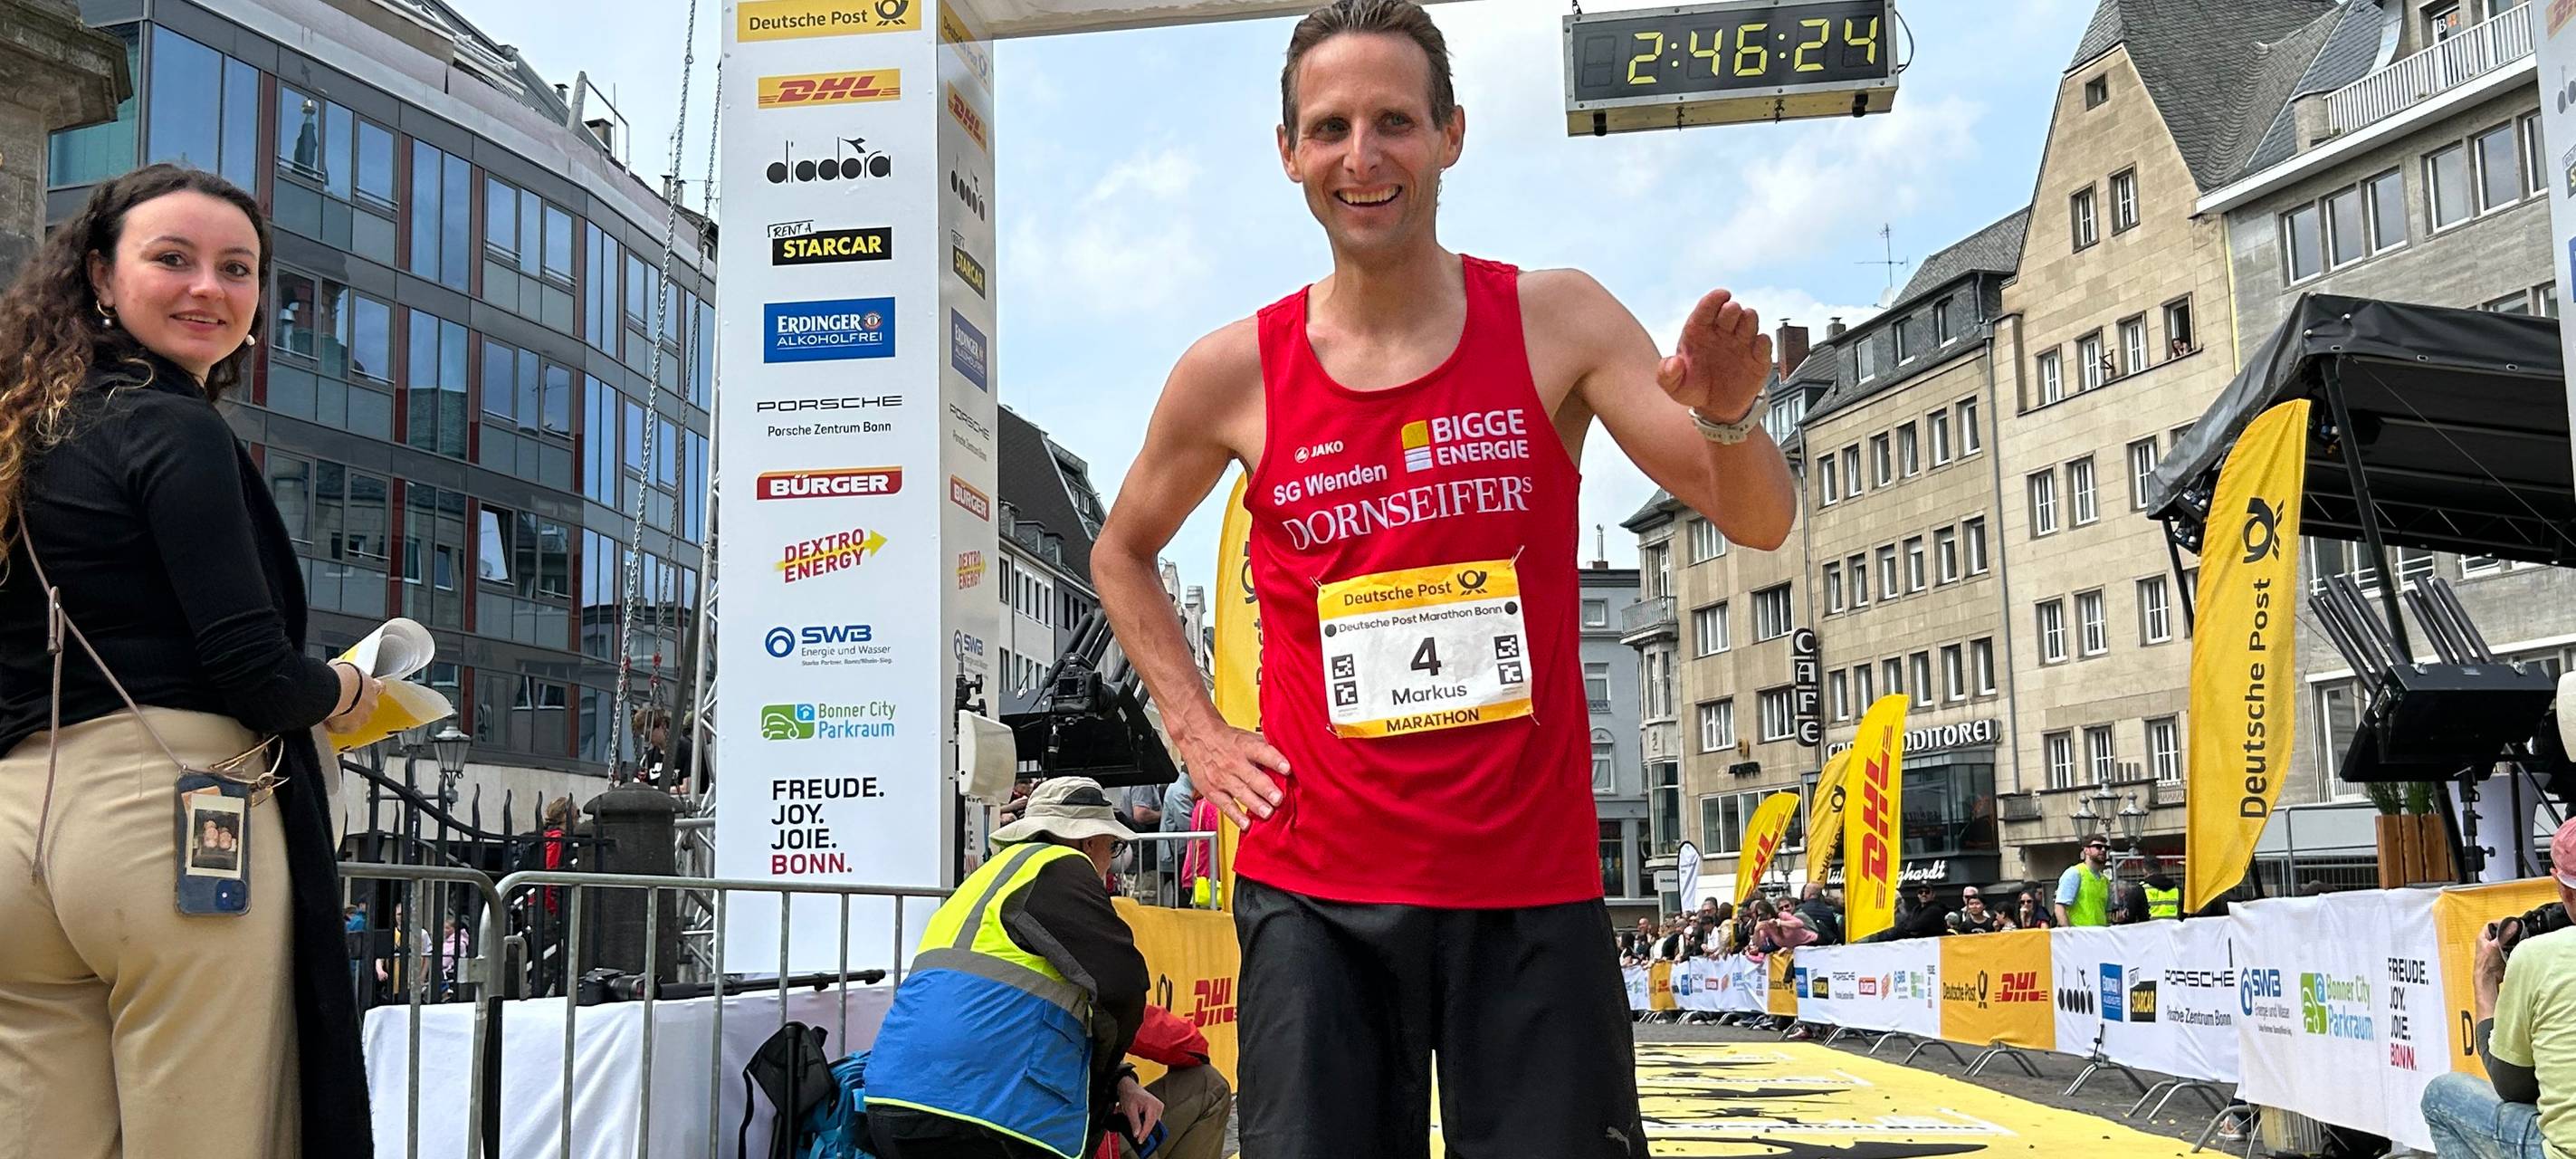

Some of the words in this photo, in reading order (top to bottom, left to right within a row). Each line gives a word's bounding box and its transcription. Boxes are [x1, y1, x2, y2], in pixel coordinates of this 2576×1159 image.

[749, 14, 827, 32] Deutsche
[831, 9, 869, 25] Post
[1627, 16, 1880, 86] 2:46:24
[777, 75, 885, 103] DHL
[953, 93, 983, 141] DHL
[766, 137, 892, 185] diadora
[773, 225, 802, 238] RENT
[804, 223, 813, 235] A
[783, 235, 883, 259] STARCAR
[956, 251, 984, 289] STARCAR
[777, 314, 863, 335] ERDINGER
[777, 332, 883, 348] ALKOHOLFREI
[757, 396, 903, 414] PORSCHE
[768, 424, 812, 437] Porsche
[814, 423, 861, 436] Zentrum
[863, 421, 892, 435] Bonn
[949, 403, 989, 441] PORSCHE
[1432, 409, 1528, 444] BIGGE
[1311, 440, 1345, 458] JAKO
[1436, 439, 1530, 466] ENERGIE
[769, 474, 890, 498] BÜRGER
[1274, 484, 1302, 507] SG
[1304, 463, 1388, 500] Wenden
[784, 528, 864, 564] DEXTRO
[784, 547, 865, 584] ENERGY
[959, 550, 981, 570] DEXTRO
[959, 573, 981, 589] ENERGY
[1344, 587, 1414, 607] Deutsche
[1418, 580, 1453, 598] Post
[1339, 617, 1390, 634] Deutsche
[1391, 614, 1417, 627] Post
[1419, 608, 1474, 623] Marathon
[1474, 603, 1503, 617] Bonn
[2249, 578, 2273, 652] Post
[801, 625, 873, 644] SWB
[964, 633, 984, 656] SWB
[801, 647, 835, 658] Energie
[837, 646, 855, 655] und
[858, 645, 892, 654] Wasser
[1409, 637, 1443, 677] 4
[1391, 684, 1468, 706] Markus
[1795, 631, 1820, 743] CAFE
[818, 703, 866, 719] Bonner
[869, 702, 896, 721] City
[1386, 708, 1480, 733] MARATHON
[818, 720, 895, 739] Parkraum
[1902, 719, 1991, 752] NDITOREI
[2240, 661, 2268, 819] Deutsche
[772, 777, 885, 801] FREUDE.
[771, 803, 824, 825] JOY.
[1862, 751, 1890, 884] DHL
[771, 828, 837, 850] JOIE.
[772, 853, 853, 875] BONN.
[1896, 859, 1946, 888] ghardt
[2251, 969, 2282, 997] SWB
[2388, 957, 2429, 986] FREUDE.
[1943, 982, 1964, 1001] Deutsche
[1965, 982, 1977, 1002] Post
[2001, 972, 2041, 1002] DHL
[2326, 974, 2354, 1002] Bonner
[2355, 975, 2371, 1010] City
[2390, 986, 2406, 1011] JOY.
[1194, 977, 1235, 1028] DHL
[2185, 1007, 2215, 1026] Zentrum
[2215, 1010, 2232, 1026] Bonn
[2328, 1004, 2374, 1041] Parkraum
[2390, 1014, 2410, 1041] JOIE.
[2390, 1042, 2418, 1071] BONN.
